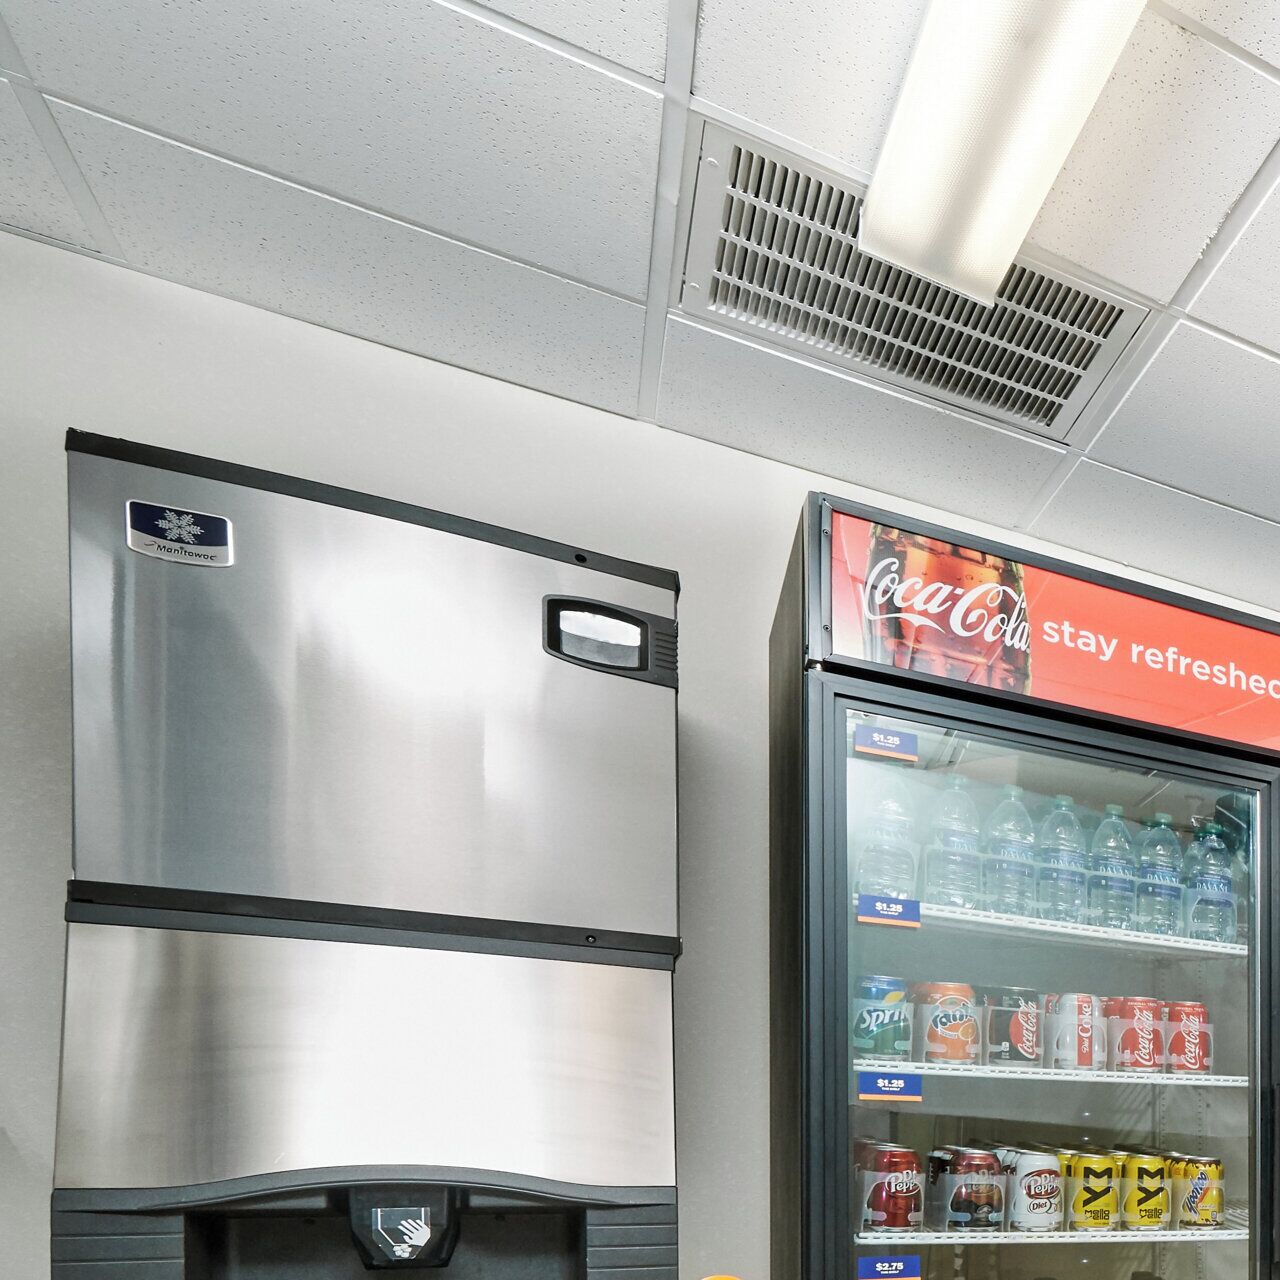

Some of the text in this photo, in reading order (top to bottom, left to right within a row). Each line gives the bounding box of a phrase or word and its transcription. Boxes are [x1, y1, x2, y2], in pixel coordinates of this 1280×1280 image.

[156, 544, 218, 562] Manitowoc
[864, 557, 1031, 654] Coca-Cola
[1042, 619, 1119, 662] stay
[872, 732, 901, 746] $1.25
[875, 903, 903, 913] $1.25
[877, 1078, 905, 1089] $1.25
[875, 1262, 904, 1271] $2.75
